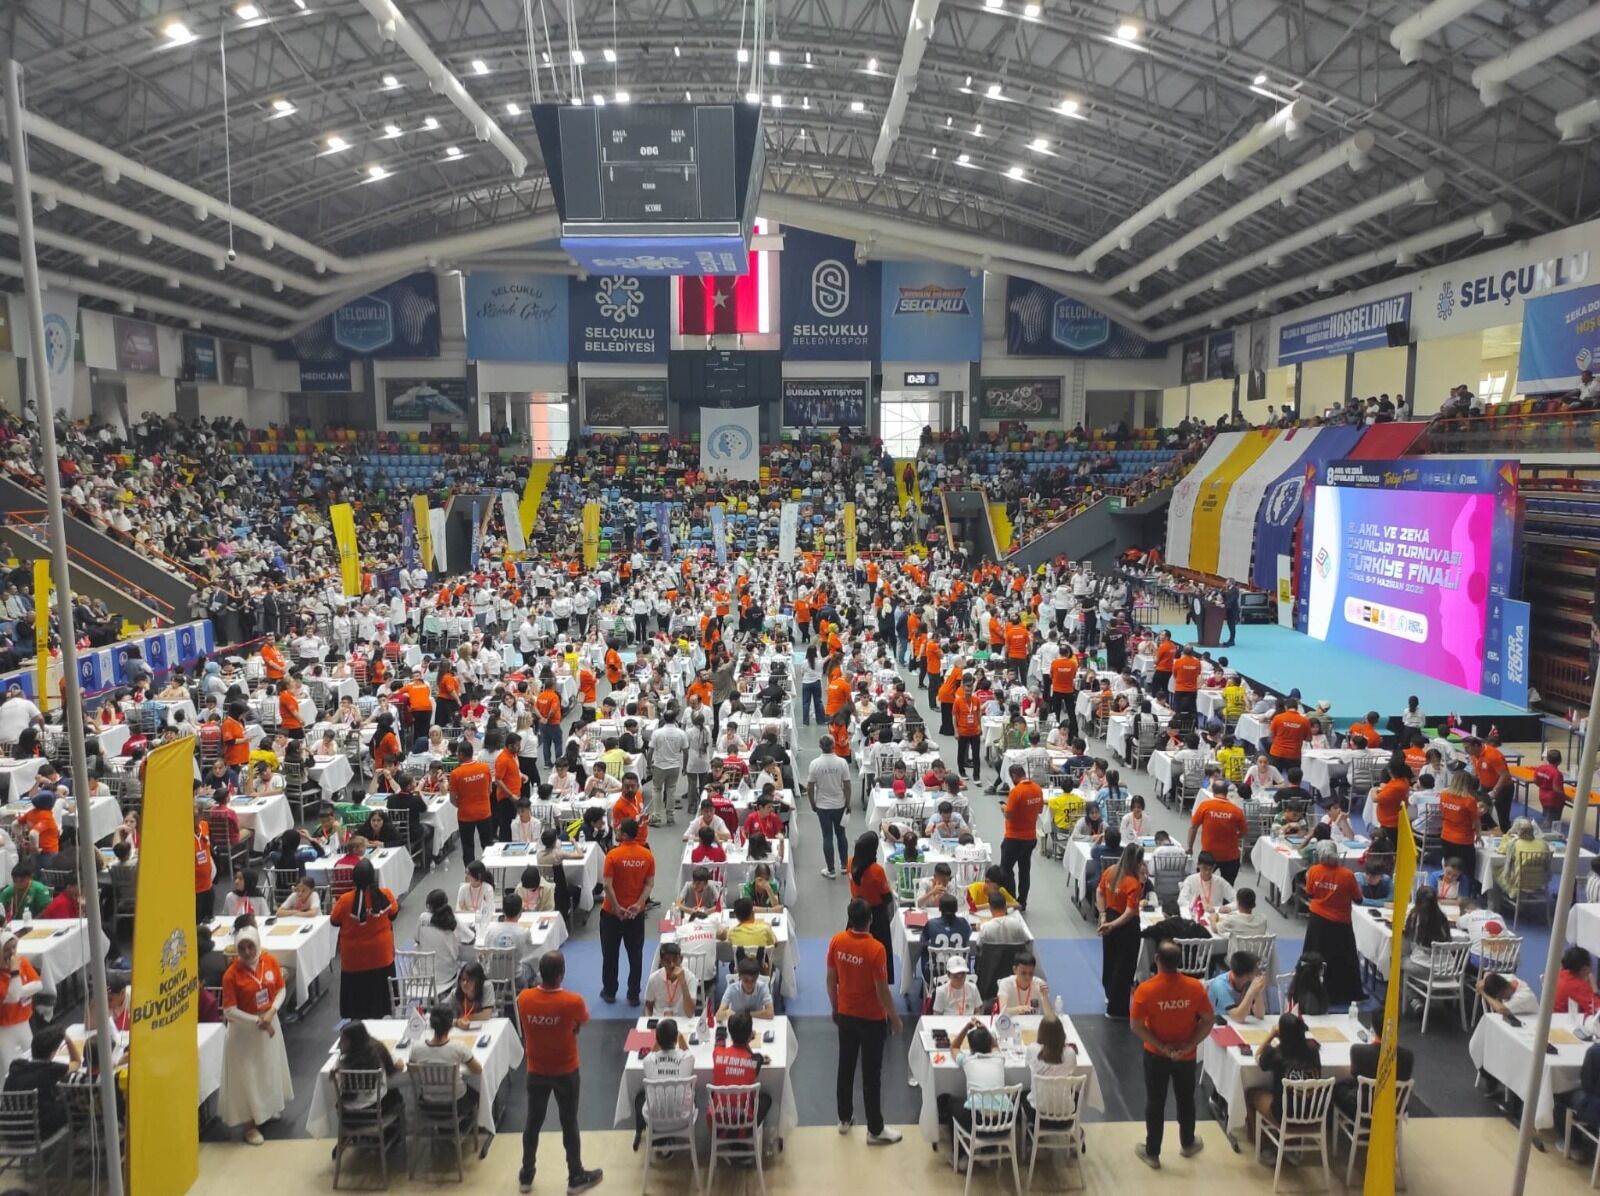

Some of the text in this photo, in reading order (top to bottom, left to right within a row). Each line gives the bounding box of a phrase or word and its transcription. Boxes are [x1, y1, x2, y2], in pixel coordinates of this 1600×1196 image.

[1460, 250, 1591, 308] SELÇUKLU
[585, 327, 655, 341] SELÇUKLU
[793, 325, 868, 337] SELÇUKLU
[585, 340, 655, 352] BELEDİYESİ
[793, 336, 868, 345] BELEDİYESPOR
[786, 388, 863, 397] BURADA YETİŞİYOR
[1383, 525, 1397, 539] VE
[1397, 544, 1463, 566] TURNUVASI
[1347, 550, 1405, 579] TÜRKİYE
[464, 773, 485, 783] TAZOF
[1209, 810, 1233, 820] TAZOF
[622, 859, 645, 868] TAZOF
[837, 951, 864, 965] TAZOF
[160, 968, 187, 995] KONYA
[1157, 1000, 1191, 1010] TAZOF
[526, 1014, 561, 1026] TAZOF
